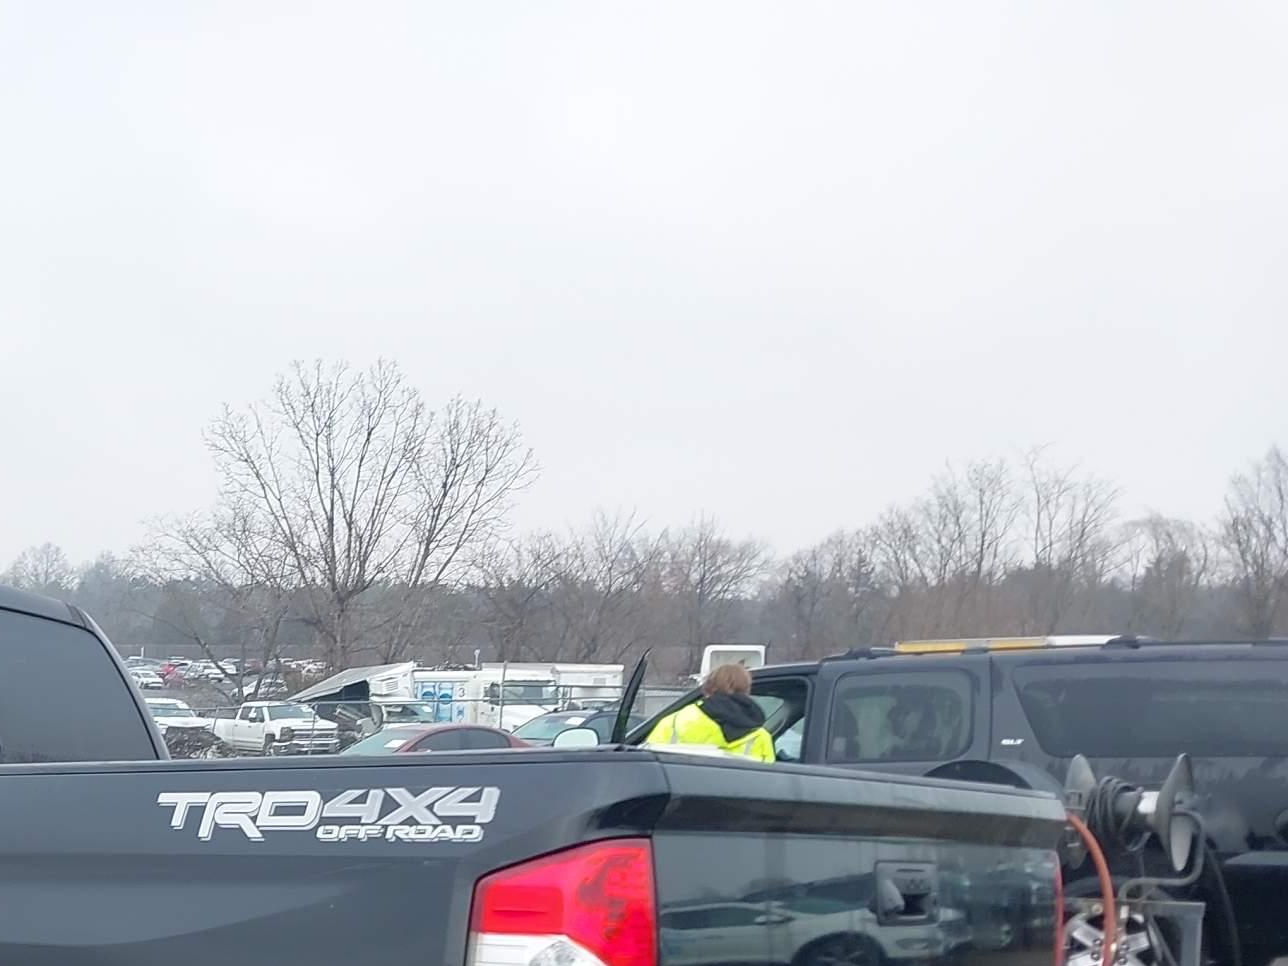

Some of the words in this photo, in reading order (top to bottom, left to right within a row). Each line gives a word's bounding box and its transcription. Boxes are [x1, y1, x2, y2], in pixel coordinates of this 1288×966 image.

[157, 790, 324, 841] TRD
[316, 825, 384, 842] OFF
[385, 825, 484, 842] ROAD
